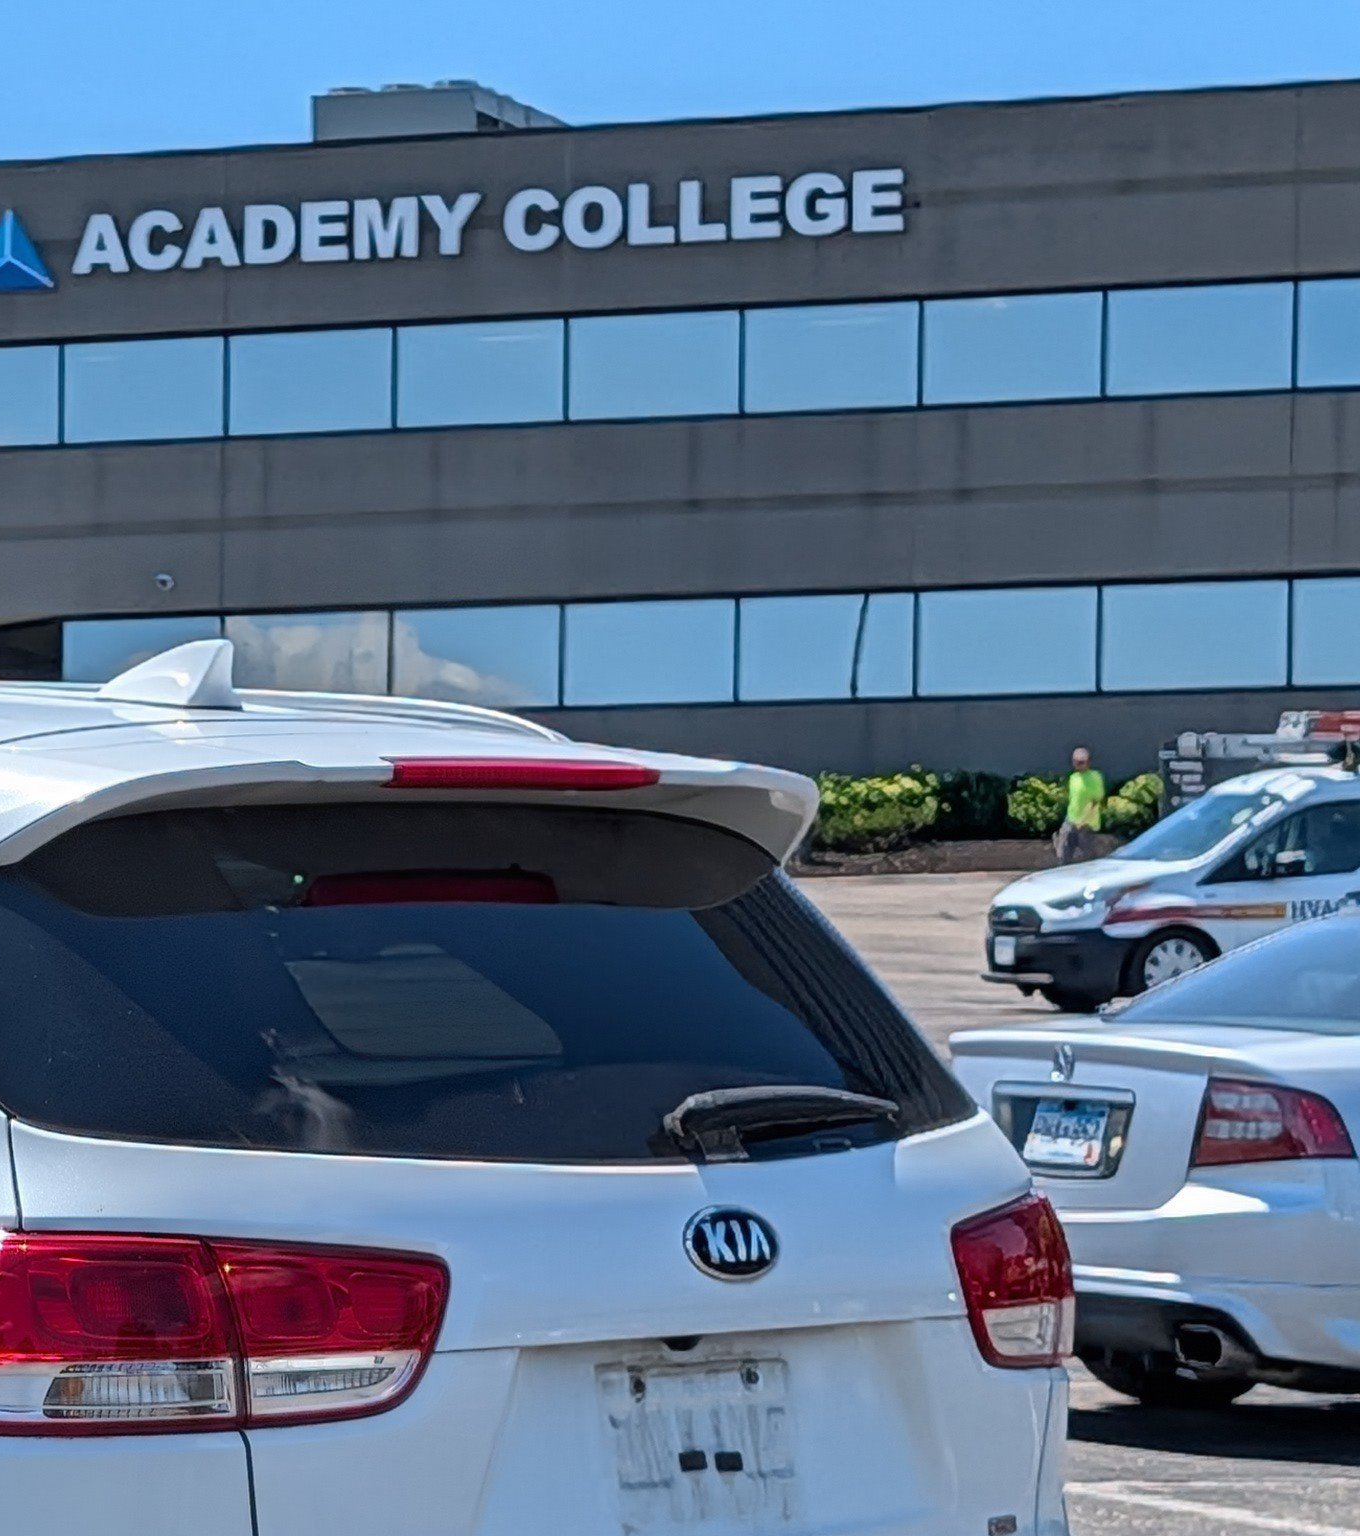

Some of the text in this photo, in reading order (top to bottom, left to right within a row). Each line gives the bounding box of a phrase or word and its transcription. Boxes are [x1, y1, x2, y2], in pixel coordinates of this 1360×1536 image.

[71, 168, 905, 275] ACADEMY COLLEGE
[700, 1219, 771, 1264] KIA
